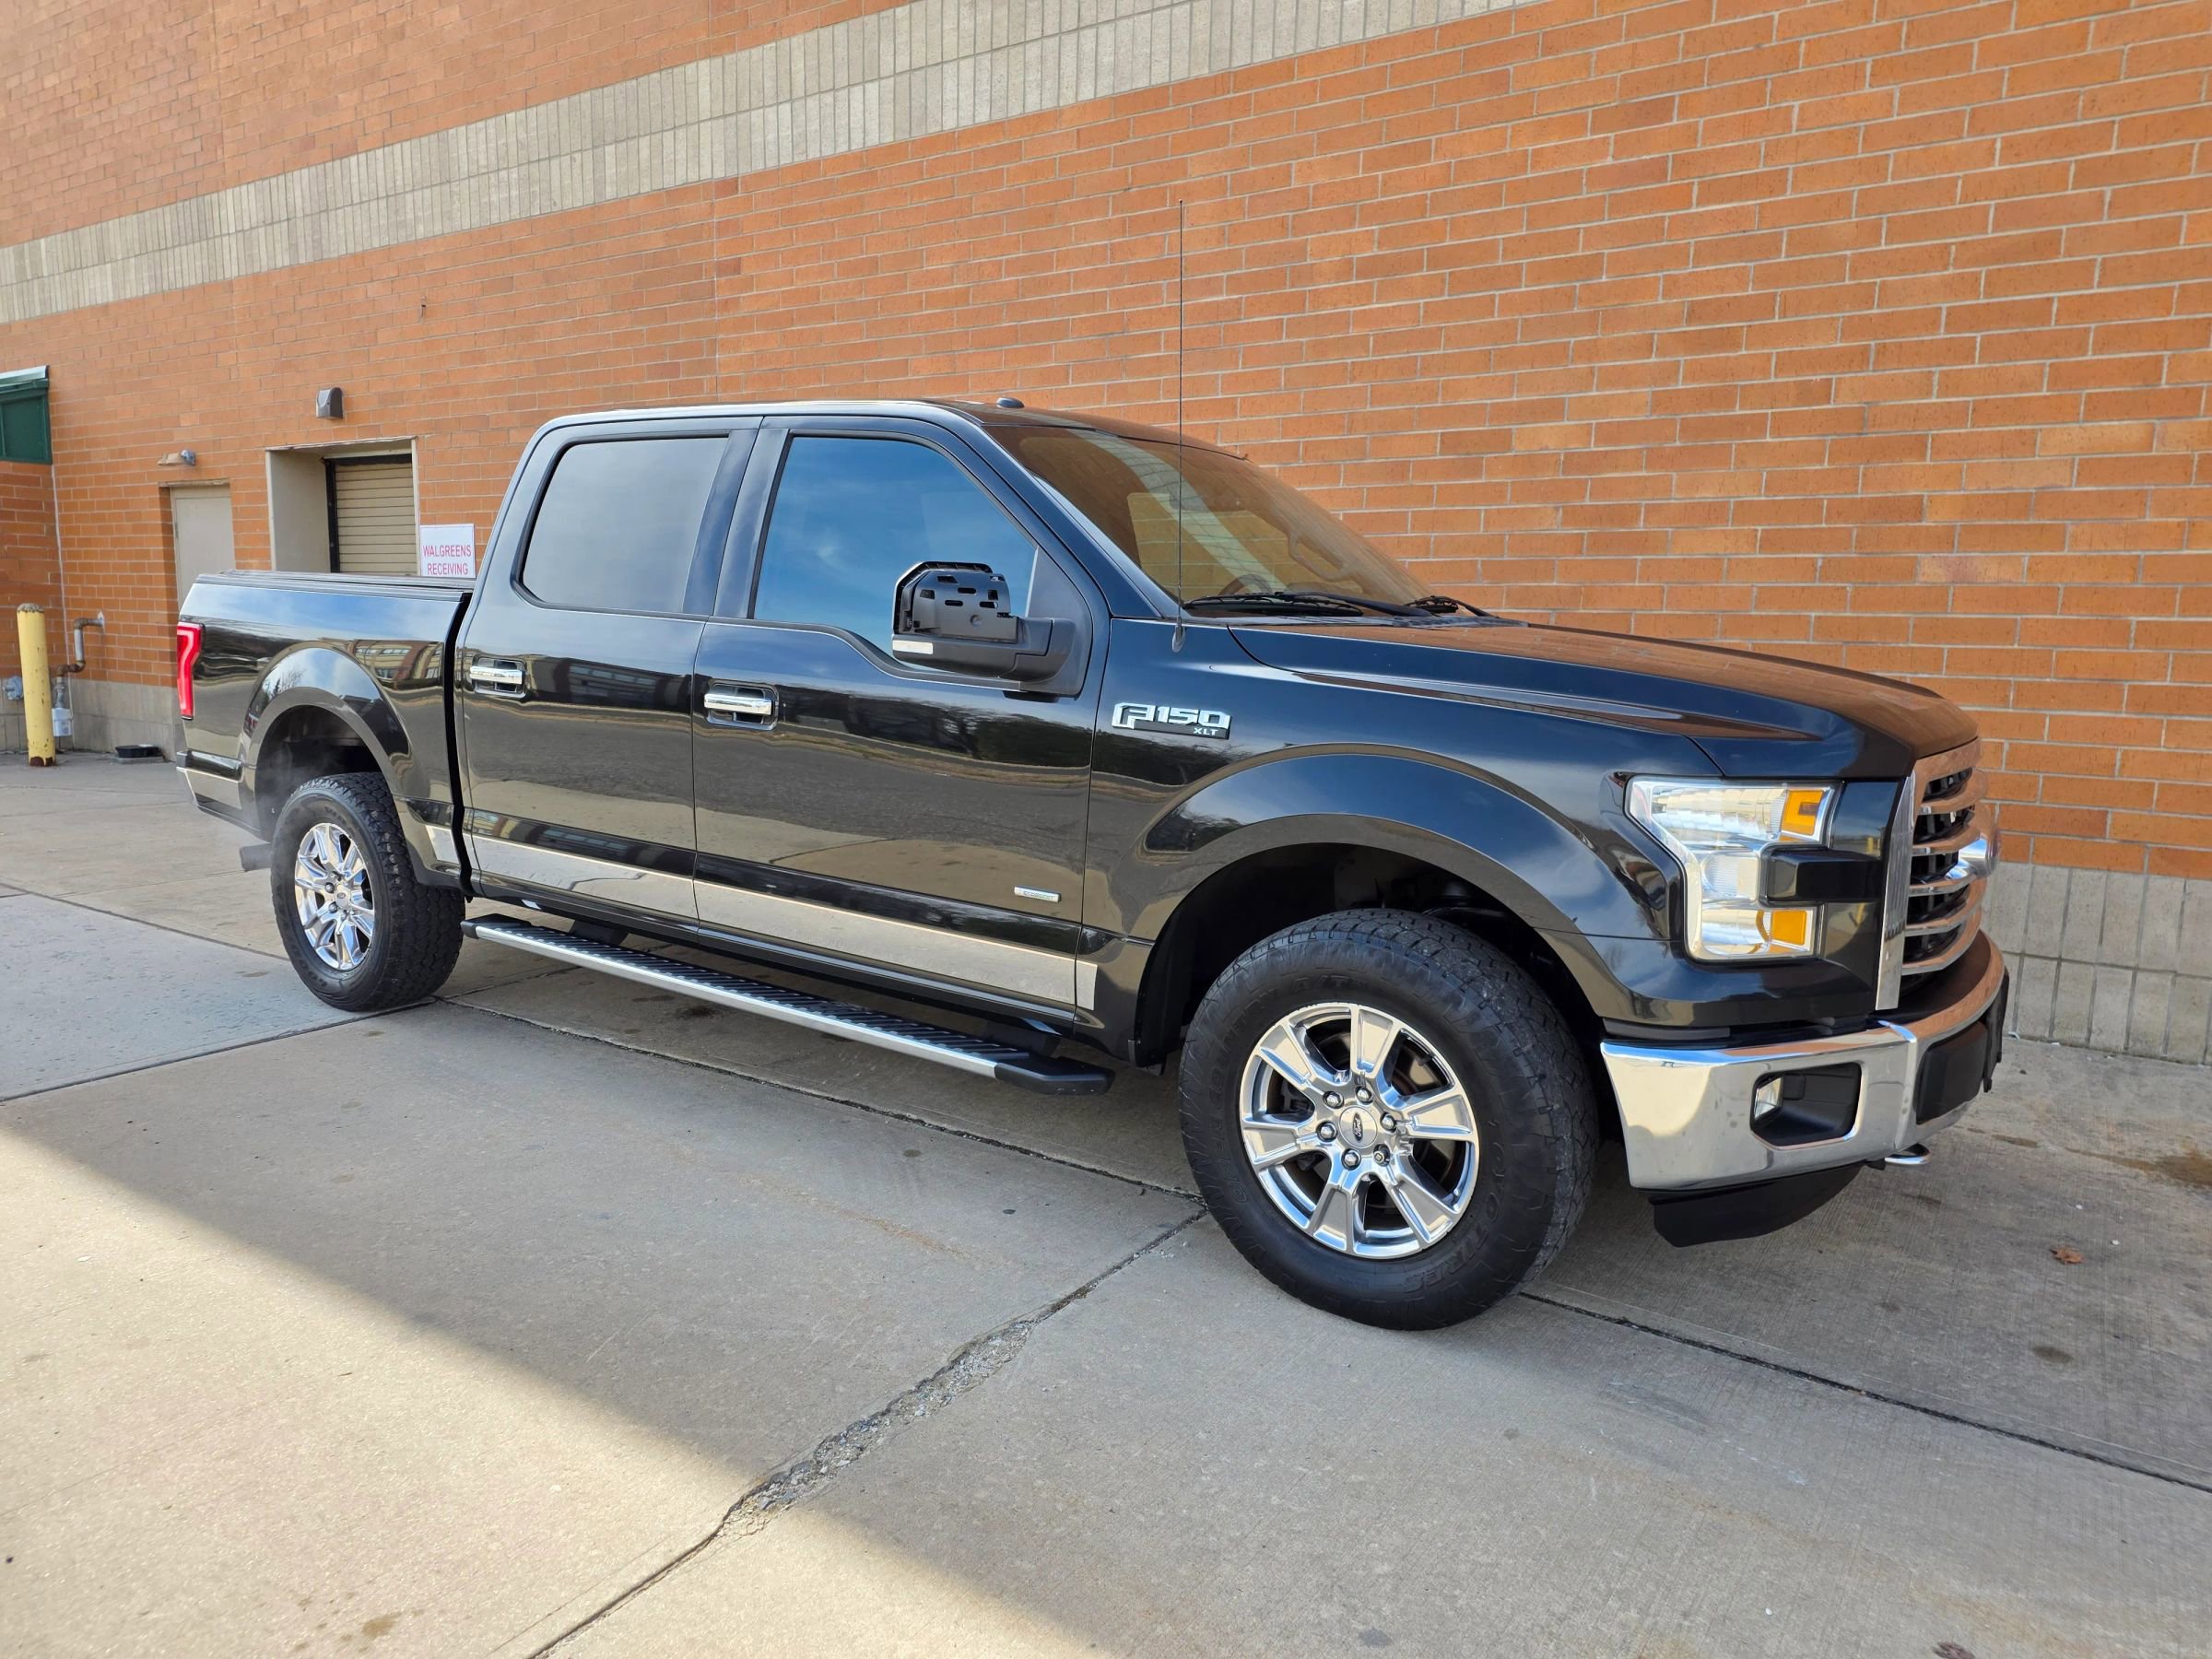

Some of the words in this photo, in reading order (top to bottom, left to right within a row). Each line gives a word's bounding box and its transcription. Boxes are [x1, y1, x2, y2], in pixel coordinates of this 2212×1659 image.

[423, 545, 472, 558] WALGREENS
[427, 562, 468, 576] RECEIVING
[1193, 727, 1219, 735] XLT
